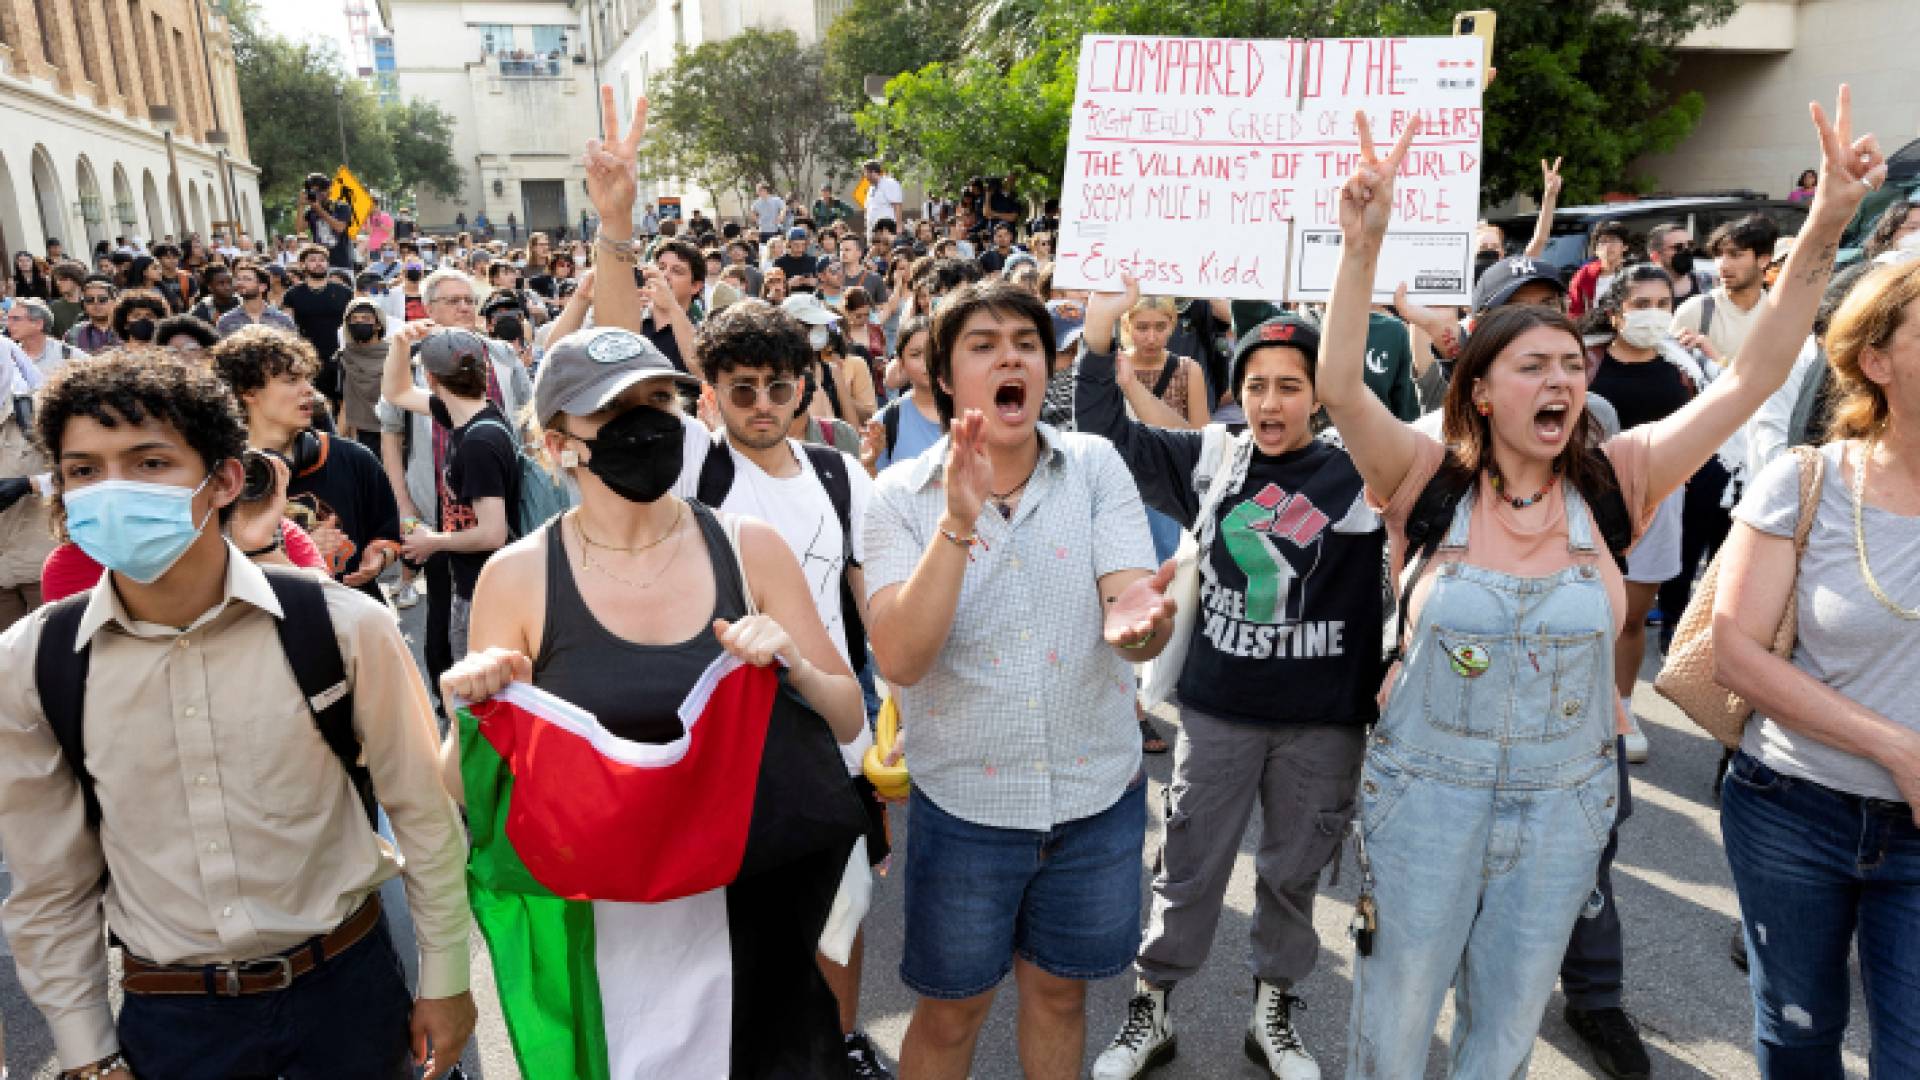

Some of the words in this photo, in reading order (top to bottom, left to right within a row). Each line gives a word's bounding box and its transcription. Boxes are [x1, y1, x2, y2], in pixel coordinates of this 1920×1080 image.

[1088, 40, 1264, 97] COMPARED
[1286, 40, 1324, 98] TO
[1339, 40, 1407, 96] THE
[1229, 108, 1303, 143] GREED
[1317, 110, 1341, 136] OF
[1078, 151, 1124, 178] THE
[1272, 153, 1304, 180] OF
[1384, 151, 1477, 182] ORLD
[1080, 183, 1134, 222] SEEM
[1145, 185, 1211, 220] MUCH
[1230, 188, 1295, 224] MORE
[1199, 250, 1265, 289] Kidd
[1201, 582, 1245, 620] FREE
